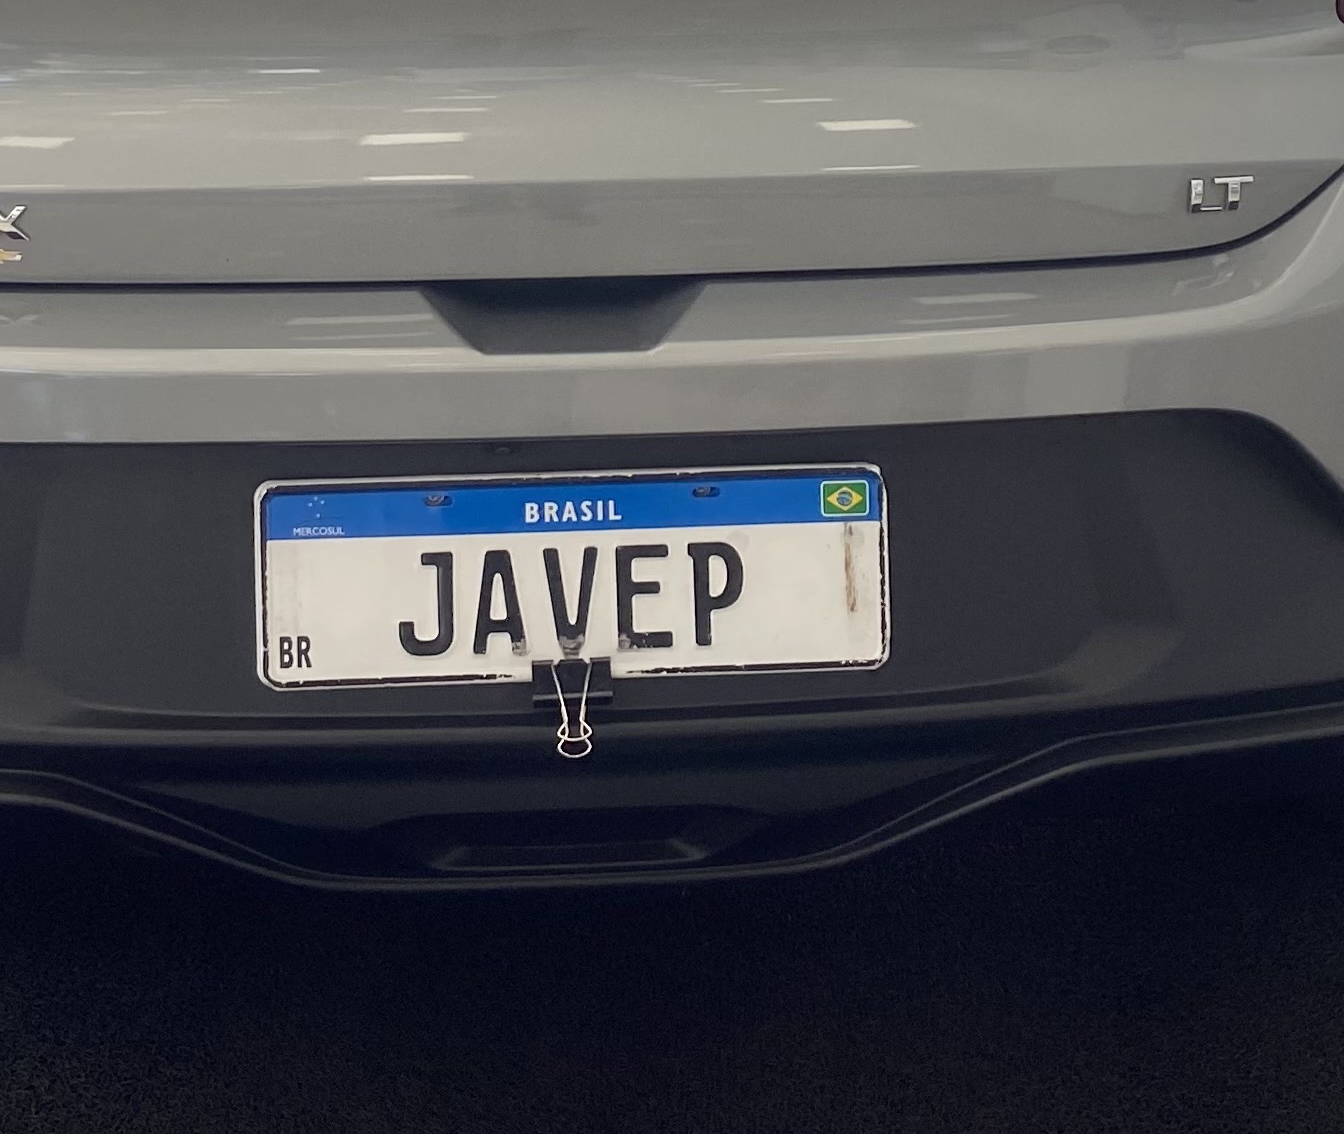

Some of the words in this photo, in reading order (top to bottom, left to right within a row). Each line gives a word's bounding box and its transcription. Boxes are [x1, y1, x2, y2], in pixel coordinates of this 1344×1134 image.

[1187, 175, 1255, 213] LT
[524, 500, 623, 524] BRASIL
[292, 526, 346, 537] MERCOSUL
[398, 541, 745, 658] JAVEP
[279, 636, 313, 669] BR
